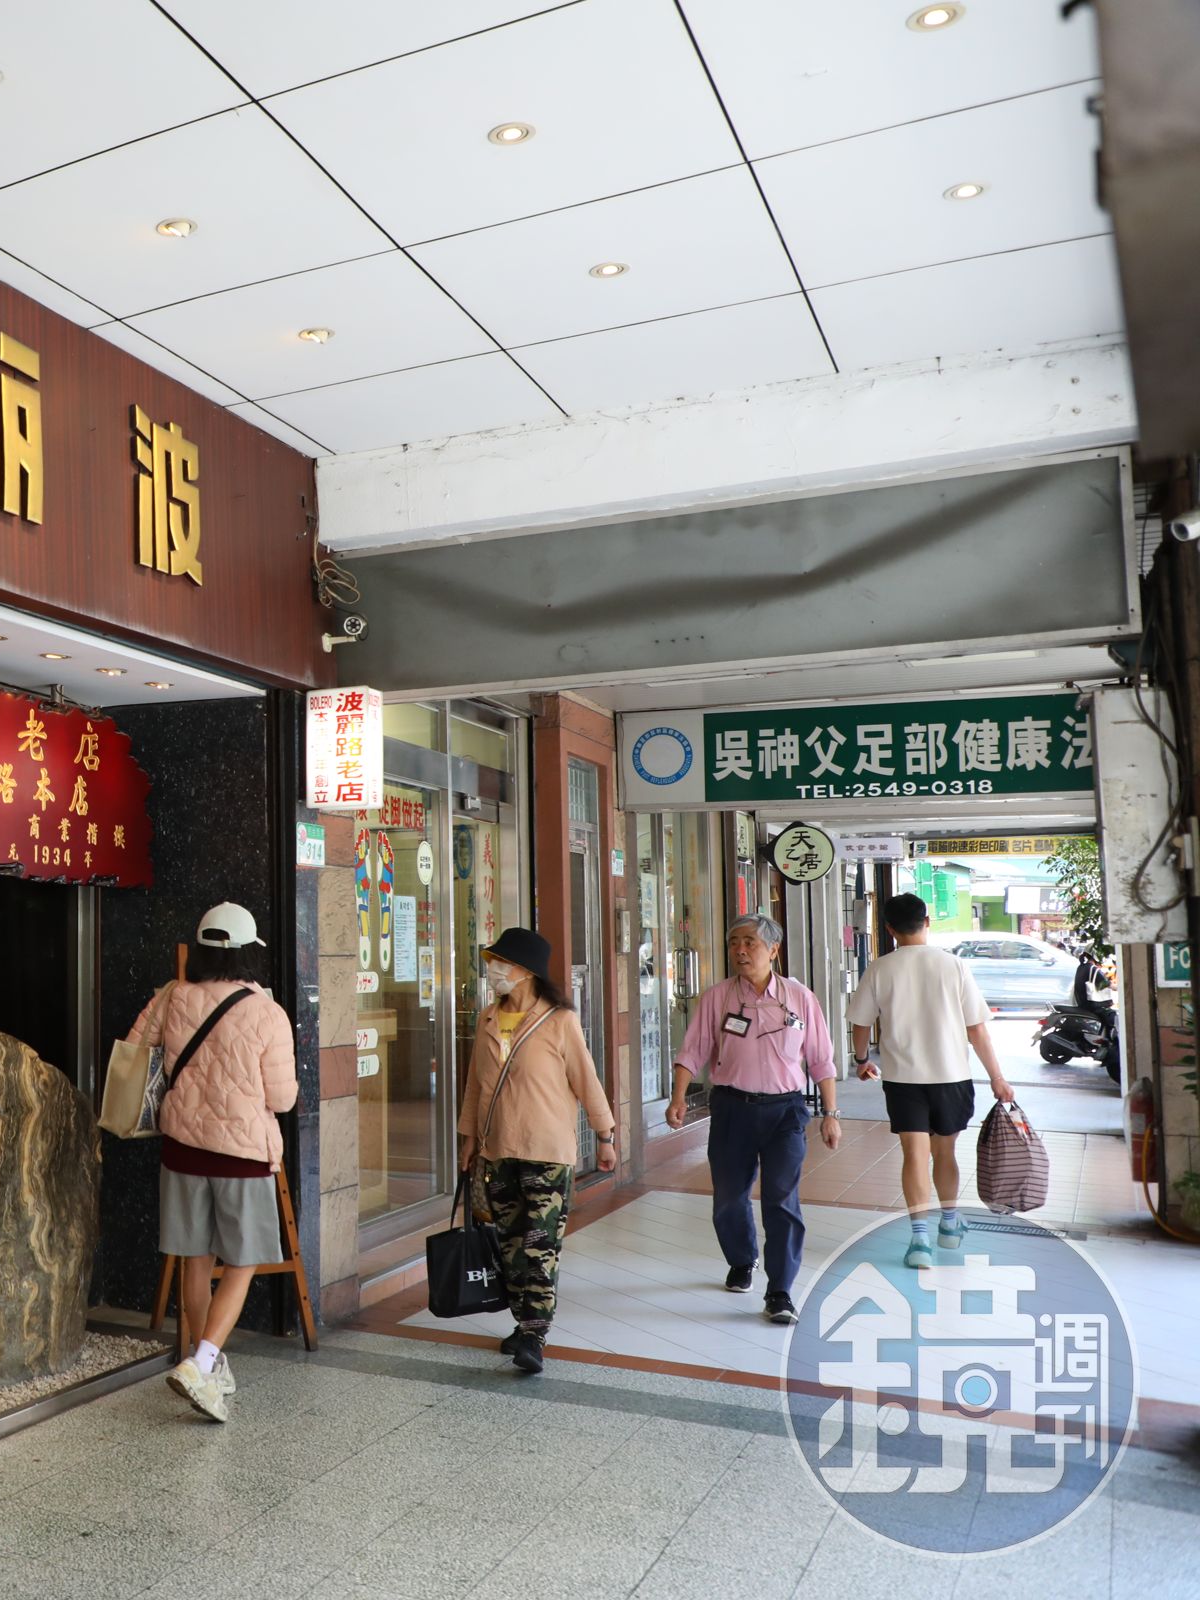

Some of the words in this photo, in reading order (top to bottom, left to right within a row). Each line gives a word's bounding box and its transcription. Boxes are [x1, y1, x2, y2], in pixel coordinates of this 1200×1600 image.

[309, 694, 333, 711] BOLERO
[335, 691, 364, 803] 波麗路老店
[712, 714, 1092, 781] 吳神父足部健康法
[796, 779, 994, 799] TEL:2549-0318
